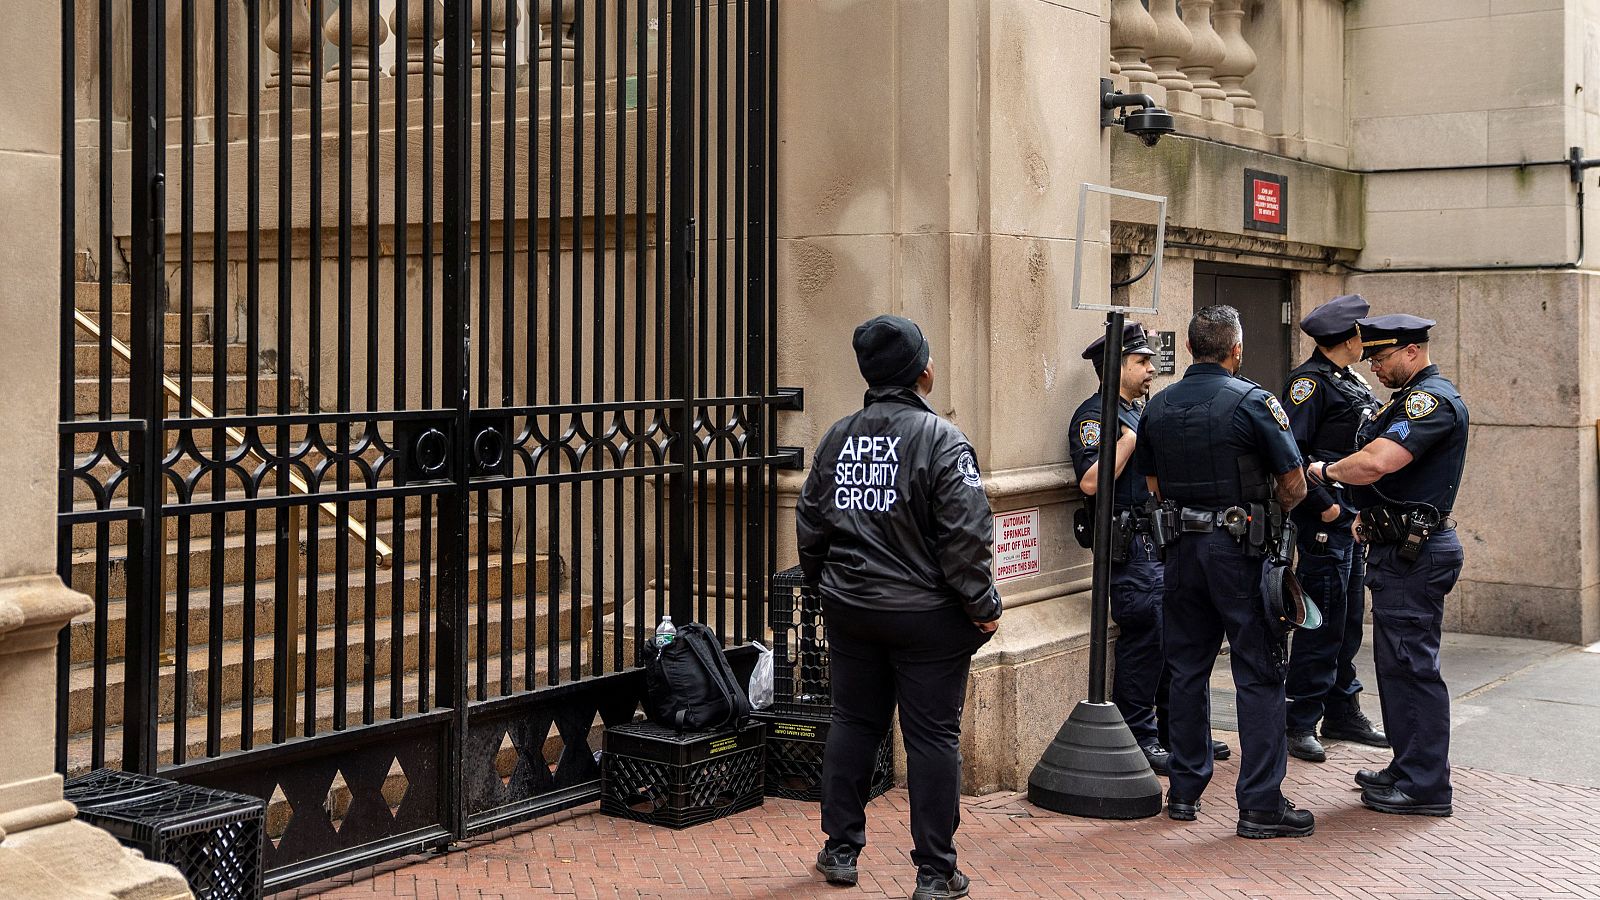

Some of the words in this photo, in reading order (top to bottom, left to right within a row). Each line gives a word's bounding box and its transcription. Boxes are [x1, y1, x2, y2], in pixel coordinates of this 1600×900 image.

[838, 436, 901, 461] APEX
[835, 463, 899, 487] SECURITY
[835, 487, 897, 511] GROUP
[1003, 515, 1030, 528] AUTOMATIC
[1004, 527, 1030, 540] SPRINKLER
[997, 542, 1010, 553] SHUT
[1012, 541, 1020, 551] OFF
[1022, 538, 1036, 548] VALVE
[1021, 550, 1030, 560] FEET
[998, 564, 1017, 576] OPPOSITE
[1018, 562, 1026, 571] THIS
[1028, 560, 1037, 570] SIGN
